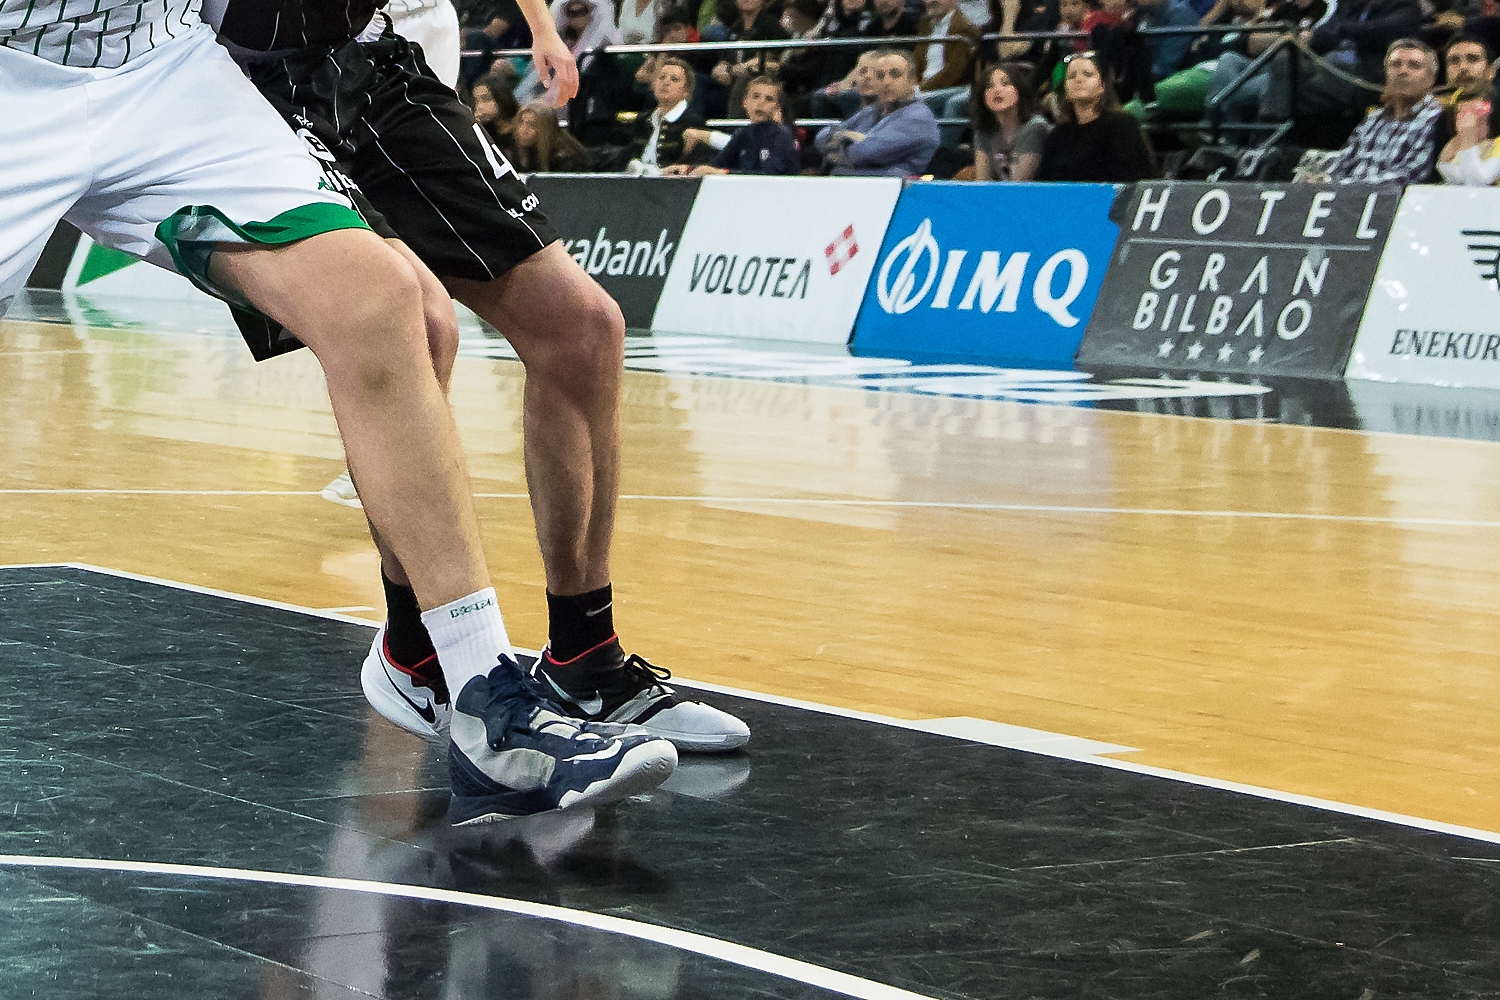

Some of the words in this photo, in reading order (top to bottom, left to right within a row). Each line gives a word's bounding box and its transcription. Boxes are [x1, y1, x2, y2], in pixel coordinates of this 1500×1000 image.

[1131, 188, 1379, 240] HOTEL
[688, 252, 812, 300] VOLOTEA
[930, 248, 1090, 328] IMQ
[1149, 250, 1331, 297] GRAN
[1132, 291, 1313, 340] BILBAO
